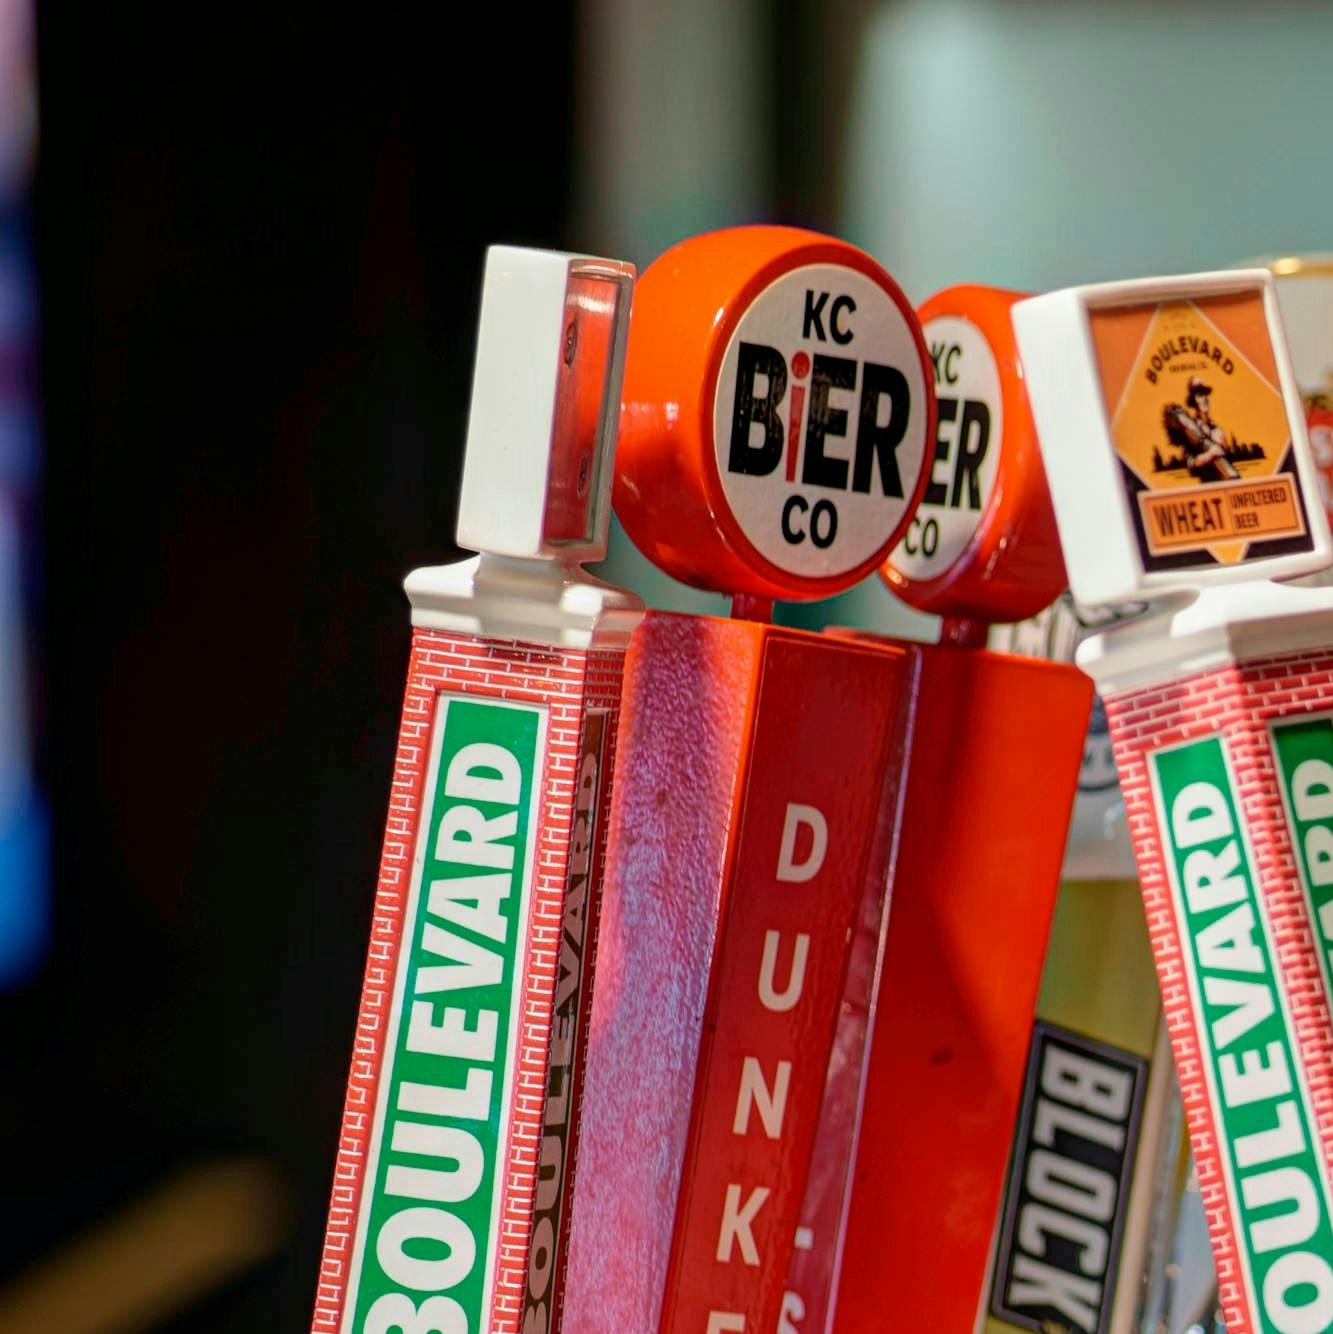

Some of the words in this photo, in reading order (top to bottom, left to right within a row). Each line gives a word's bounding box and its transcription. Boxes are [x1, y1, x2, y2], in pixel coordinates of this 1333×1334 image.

[801, 289, 857, 345] KC
[1145, 335, 1235, 385] BOULEVARD
[923, 396, 991, 511] ER
[1152, 498, 1225, 537] WHEAT
[1230, 487, 1287, 509] UNFILTERED
[780, 495, 838, 549] CO
[904, 517, 938, 558] CO
[1234, 512, 1260, 530] BEER
